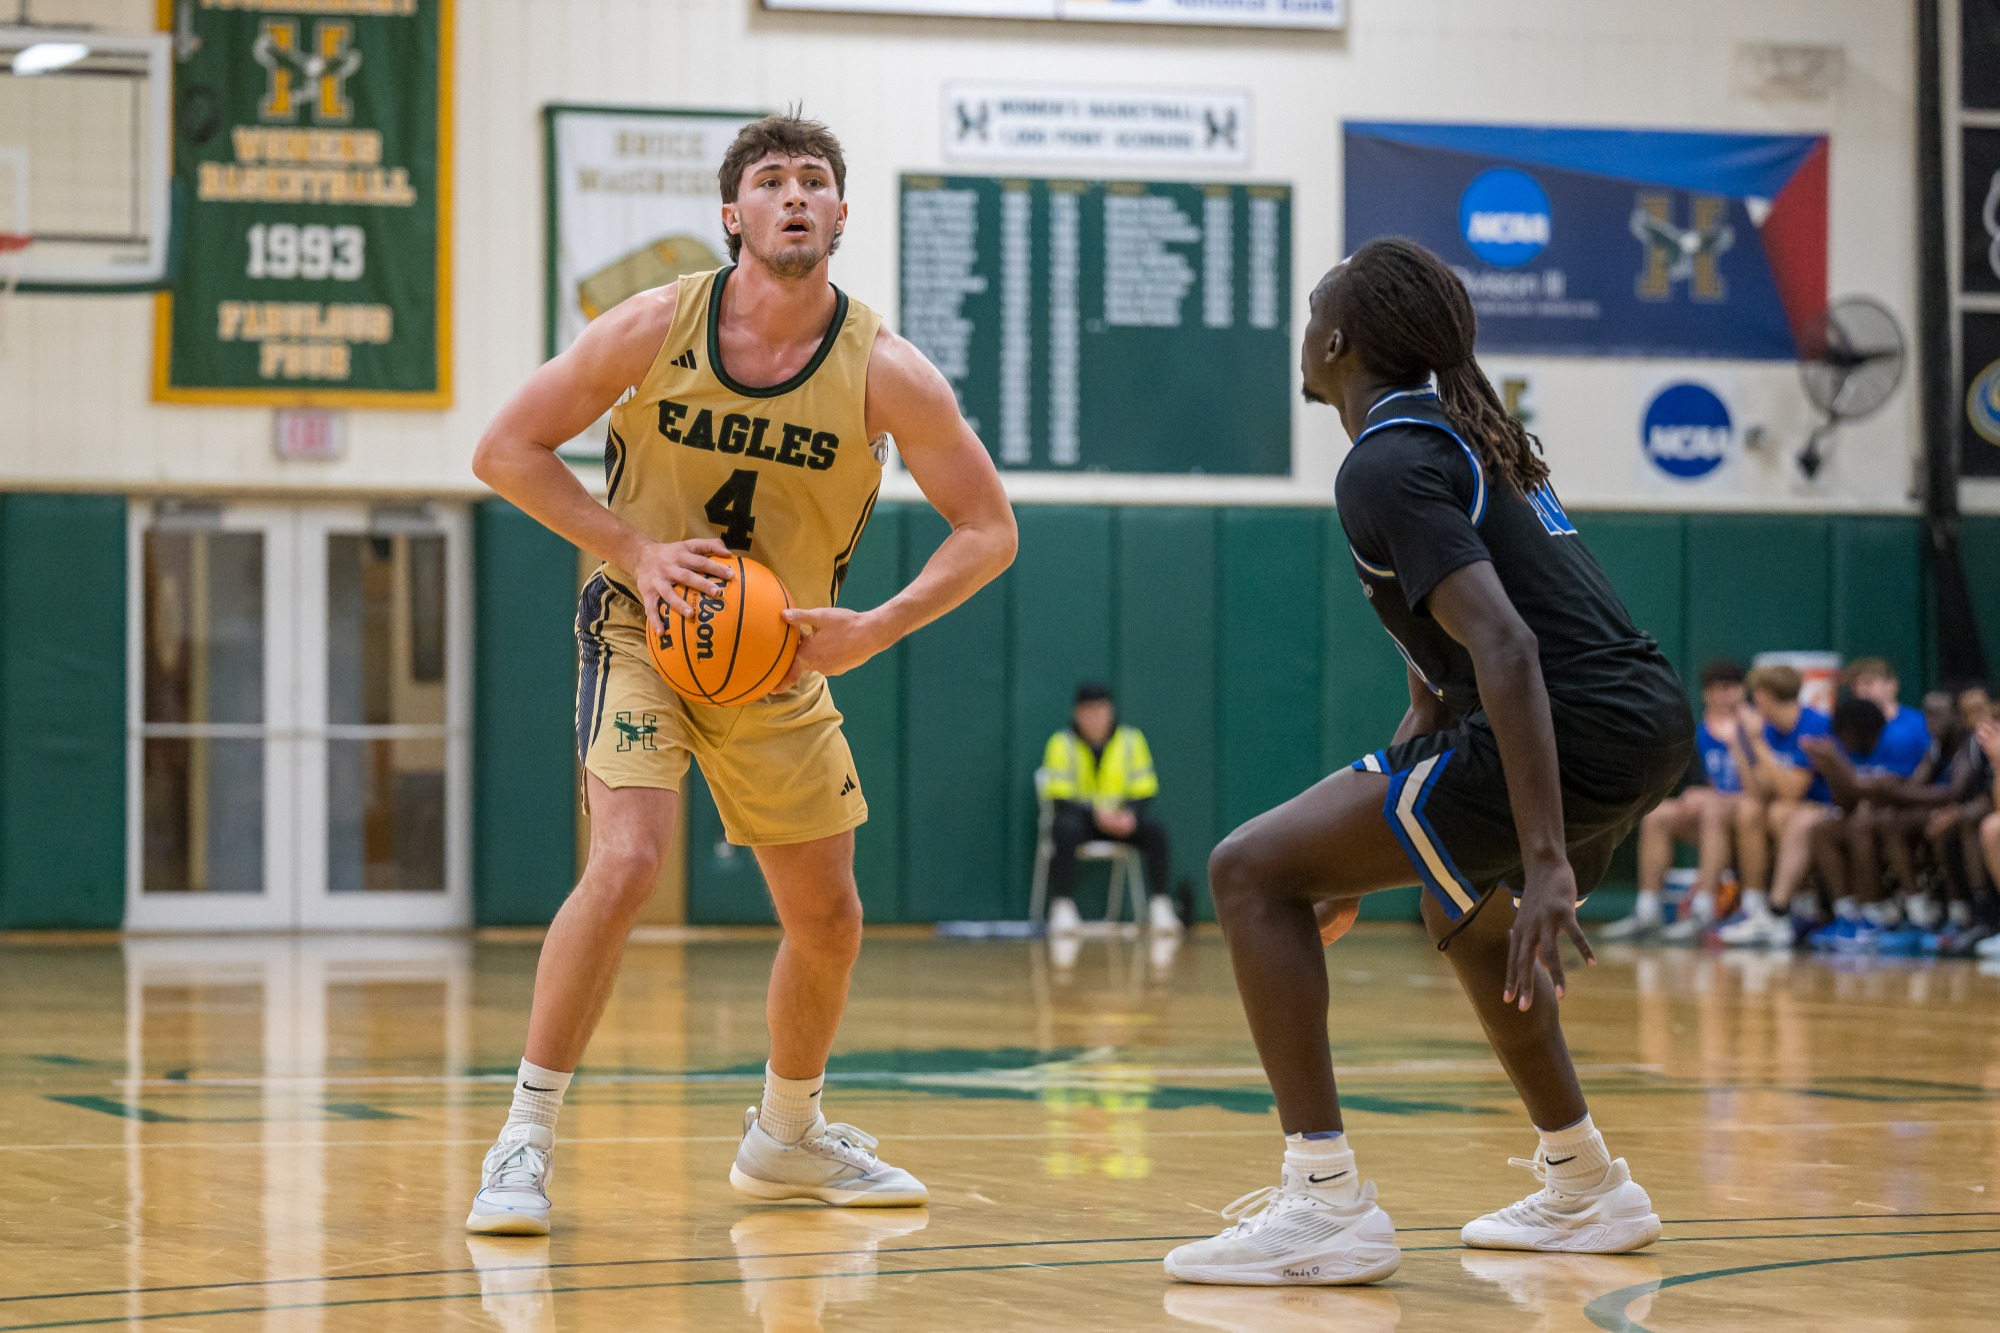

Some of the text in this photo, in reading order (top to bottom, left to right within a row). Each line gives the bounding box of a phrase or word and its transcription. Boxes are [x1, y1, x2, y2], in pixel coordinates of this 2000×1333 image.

[247, 223, 365, 281] 1993
[658, 400, 840, 471] EAGLES
[704, 468, 758, 552] 4
[697, 565, 731, 660] lson
